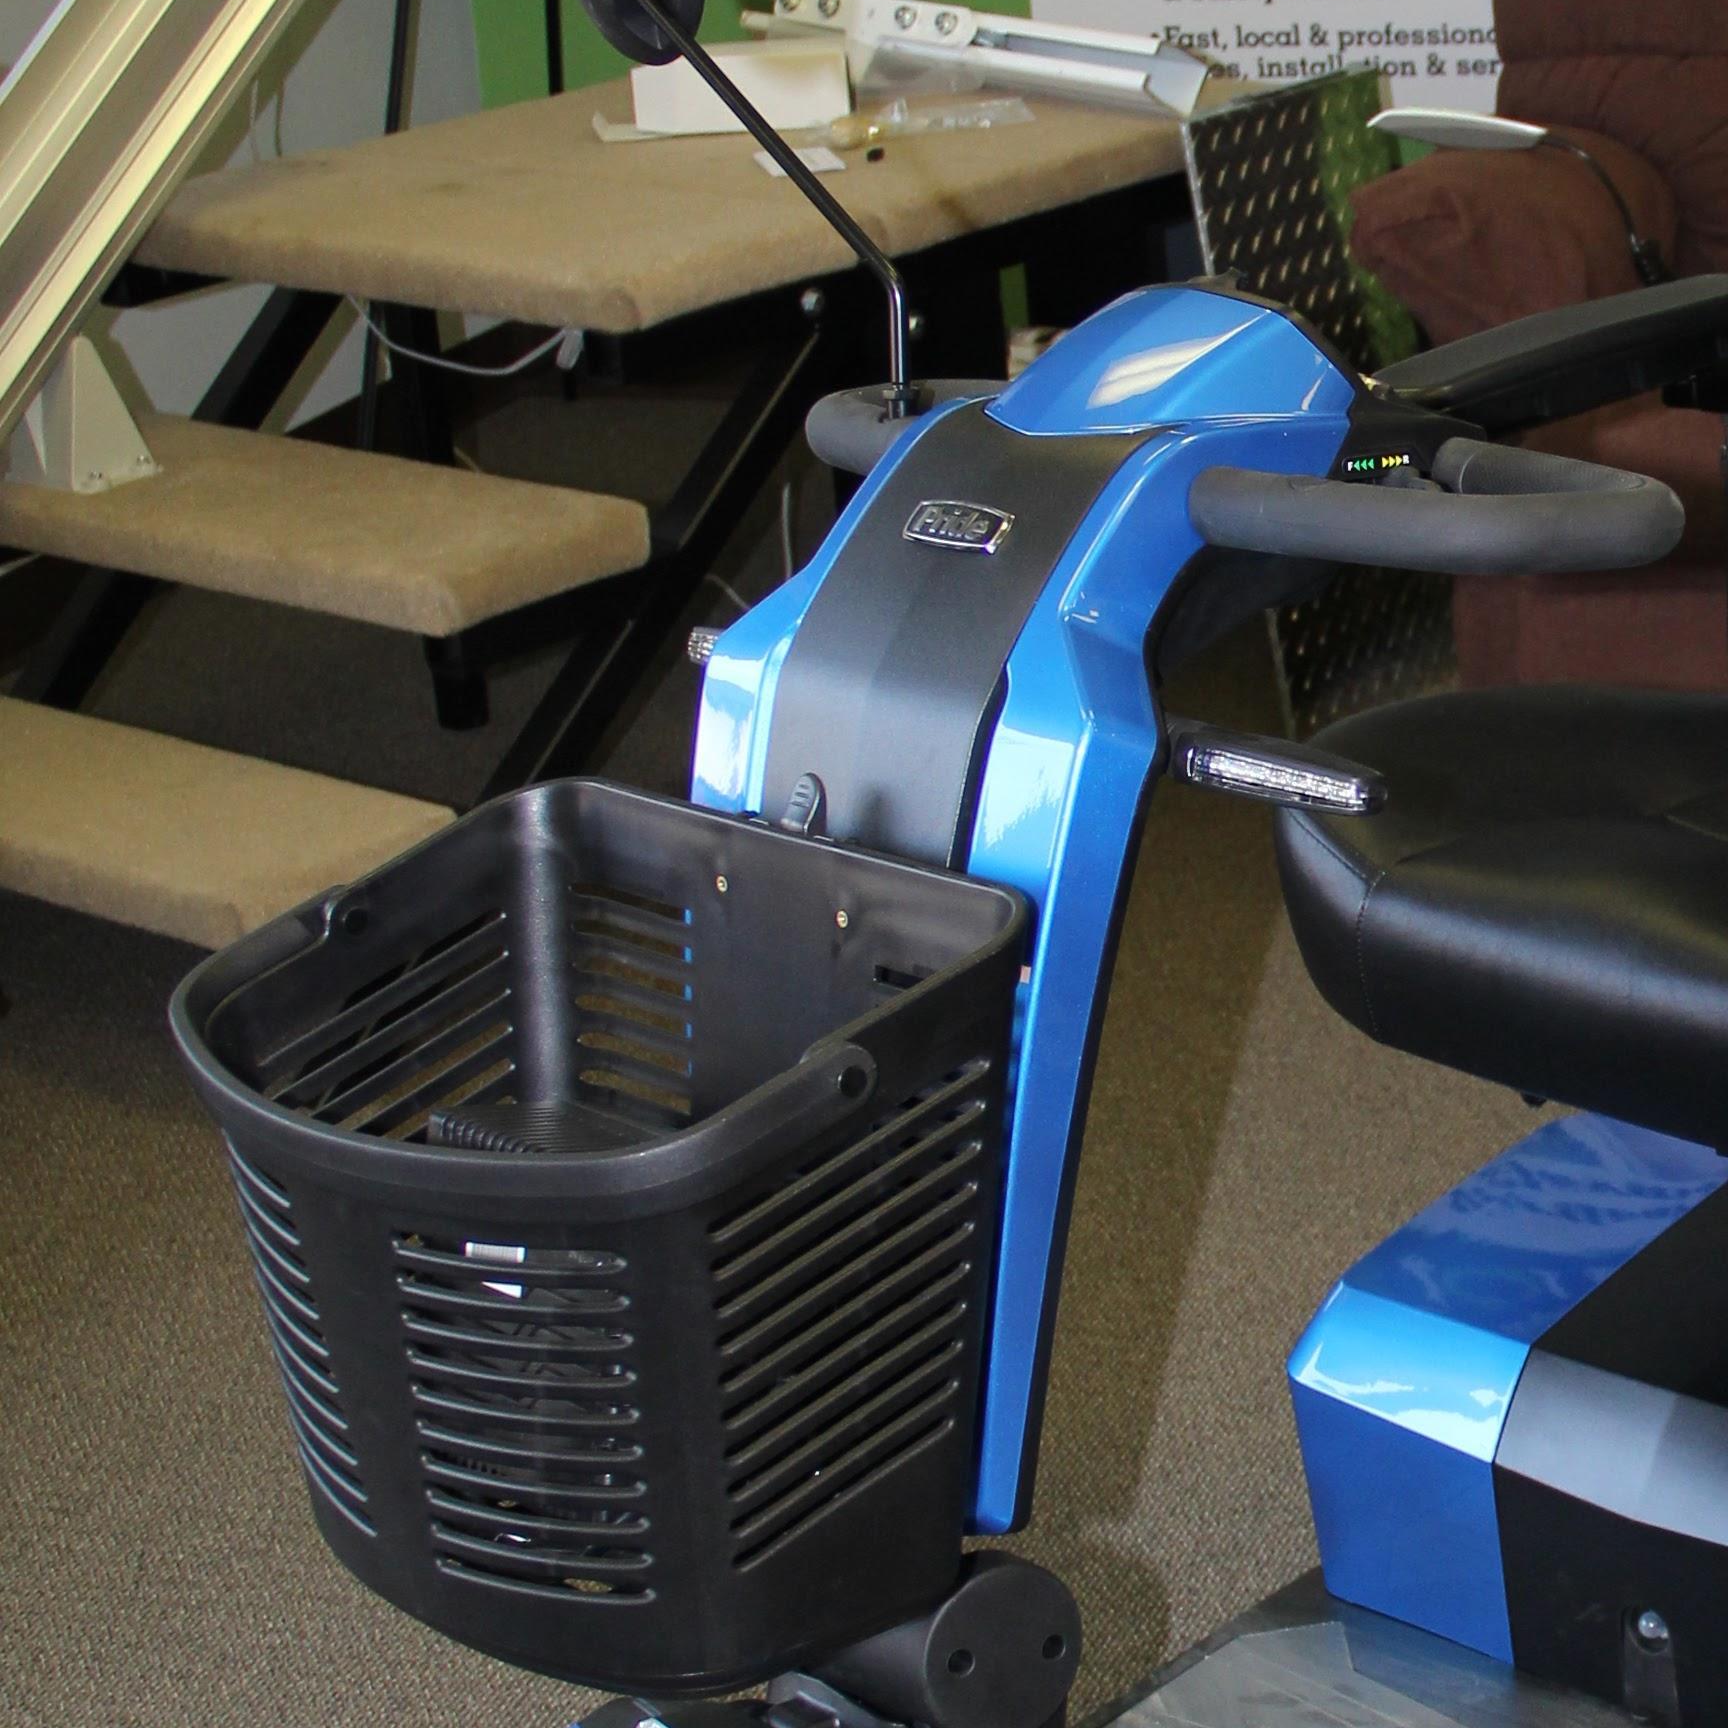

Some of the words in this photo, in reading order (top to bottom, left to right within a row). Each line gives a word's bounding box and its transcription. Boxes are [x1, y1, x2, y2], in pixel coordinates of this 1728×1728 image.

[1163, 26, 1229, 51] Fast,
[1236, 24, 1300, 47] local
[1308, 23, 1329, 45] &
[1427, 53, 1447, 76] &
[911, 505, 989, 540] Pride
